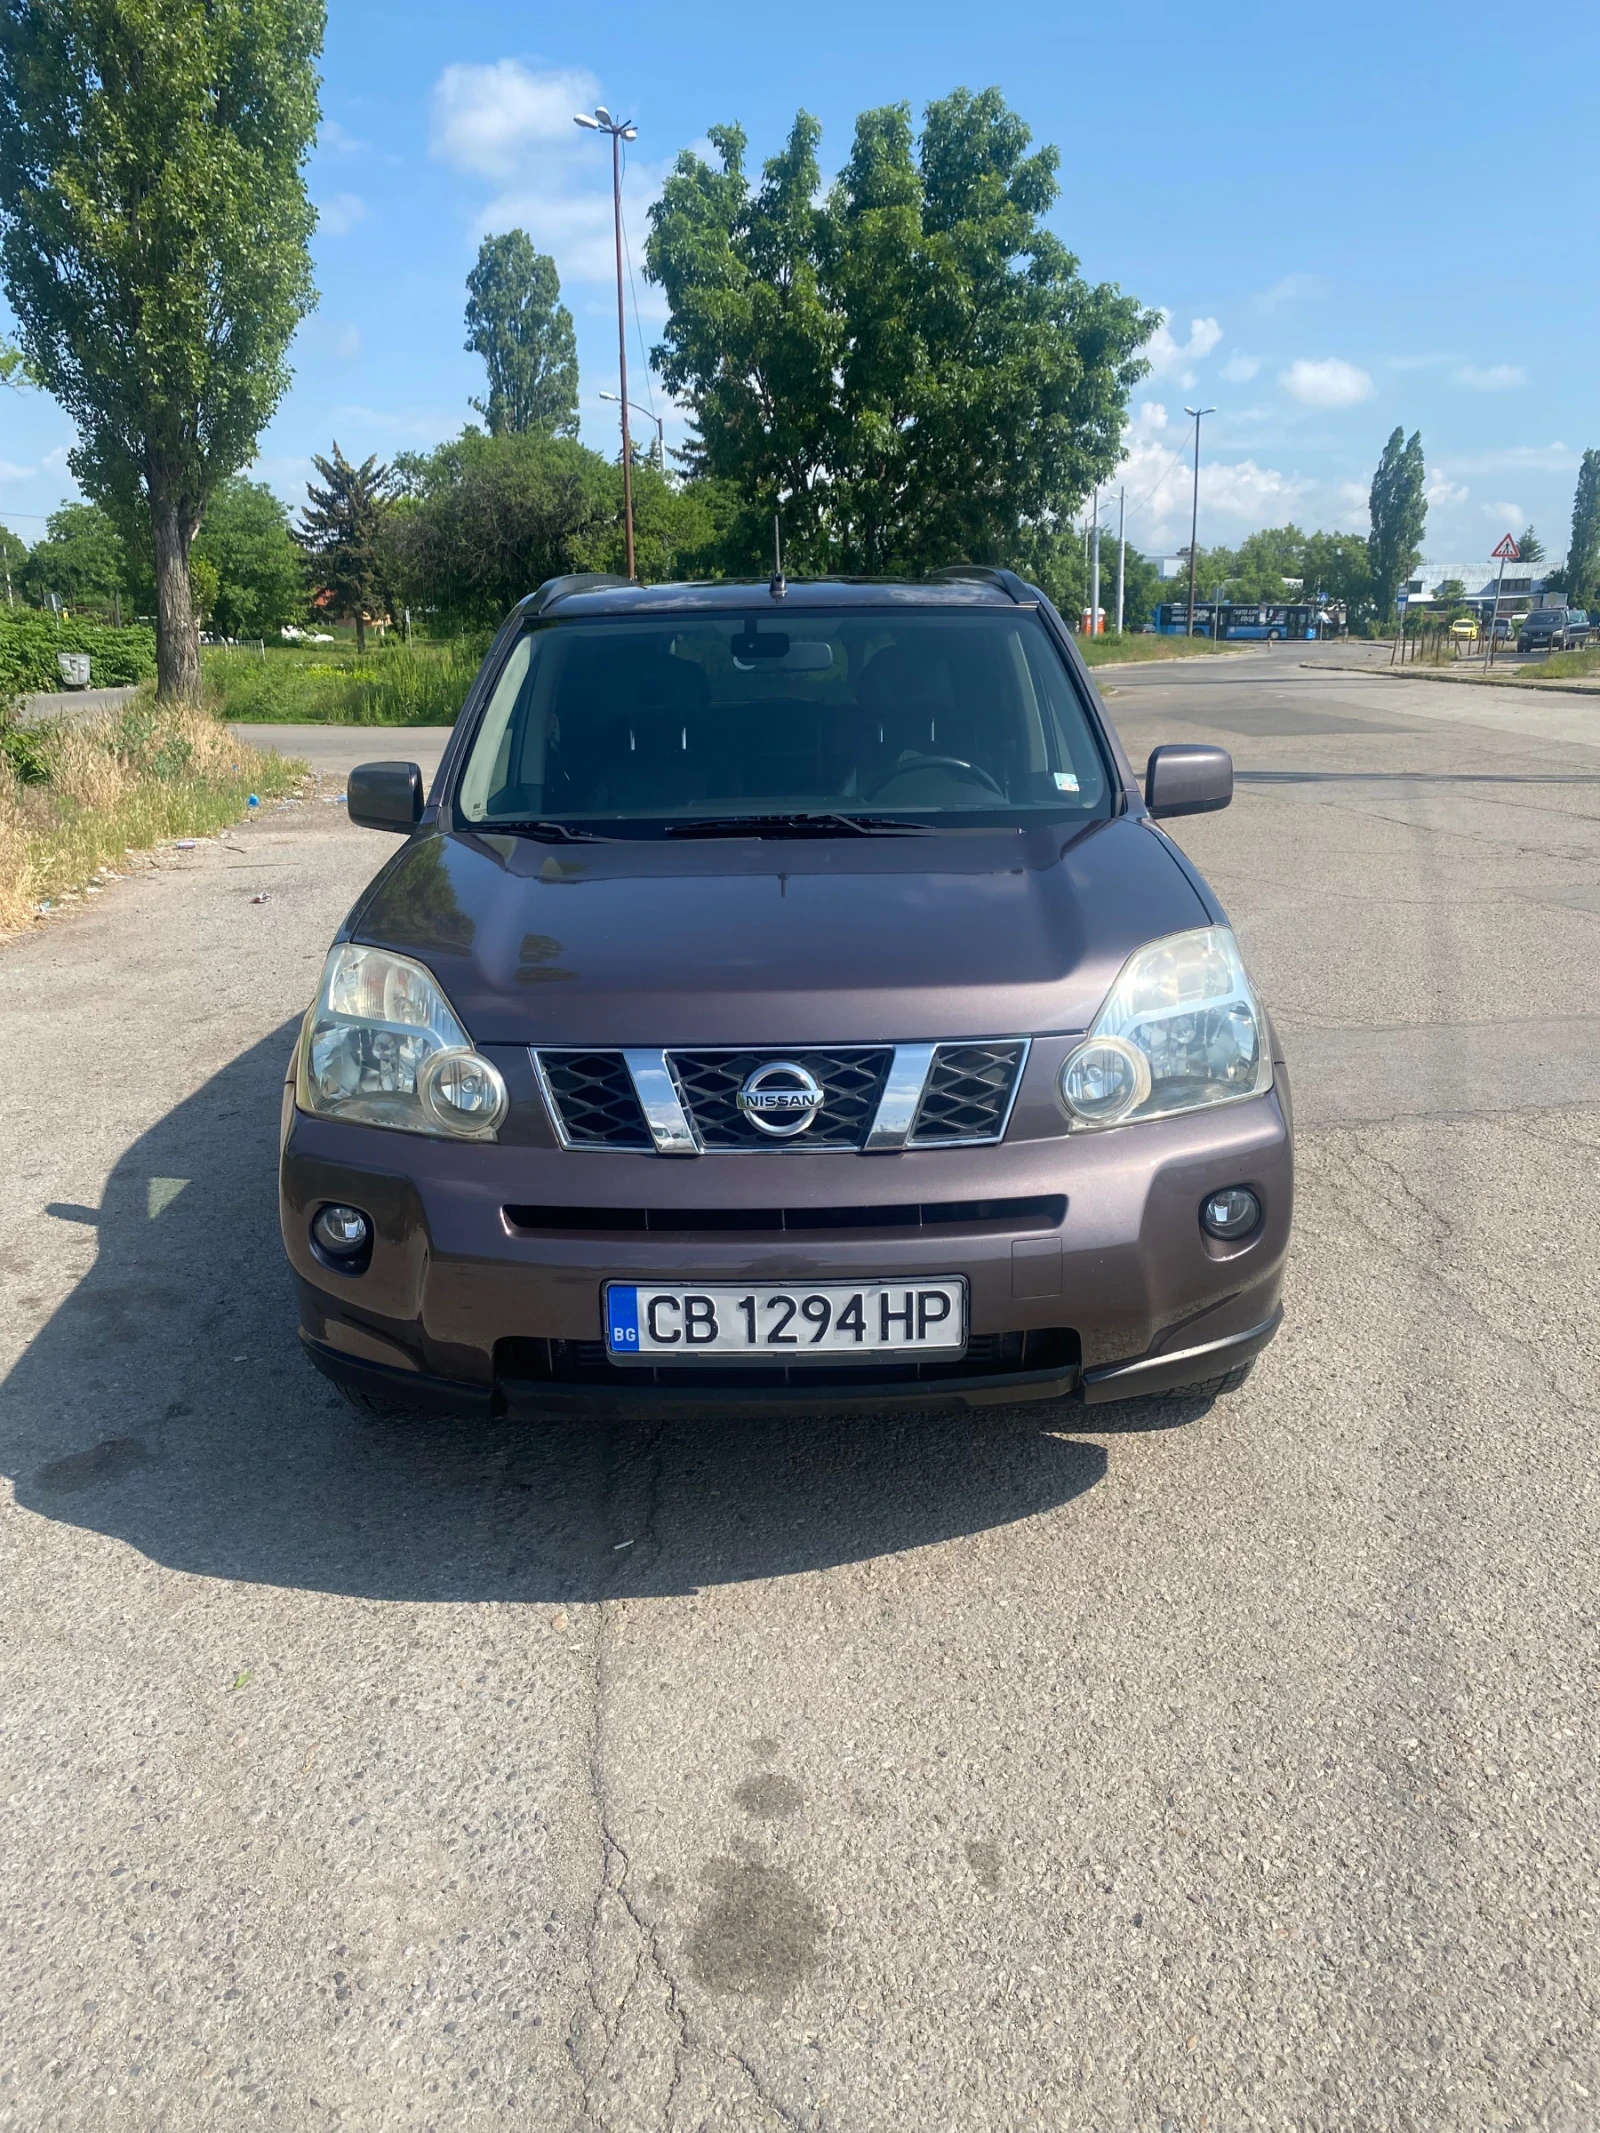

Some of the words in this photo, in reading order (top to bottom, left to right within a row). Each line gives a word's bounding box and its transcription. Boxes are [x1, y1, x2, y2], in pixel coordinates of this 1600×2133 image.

[745, 1094, 815, 1107] NISSAN
[647, 1293, 720, 1344] CB
[738, 1292, 868, 1344] 1294
[880, 1289, 952, 1341] HP
[613, 1327, 636, 1342] BG
